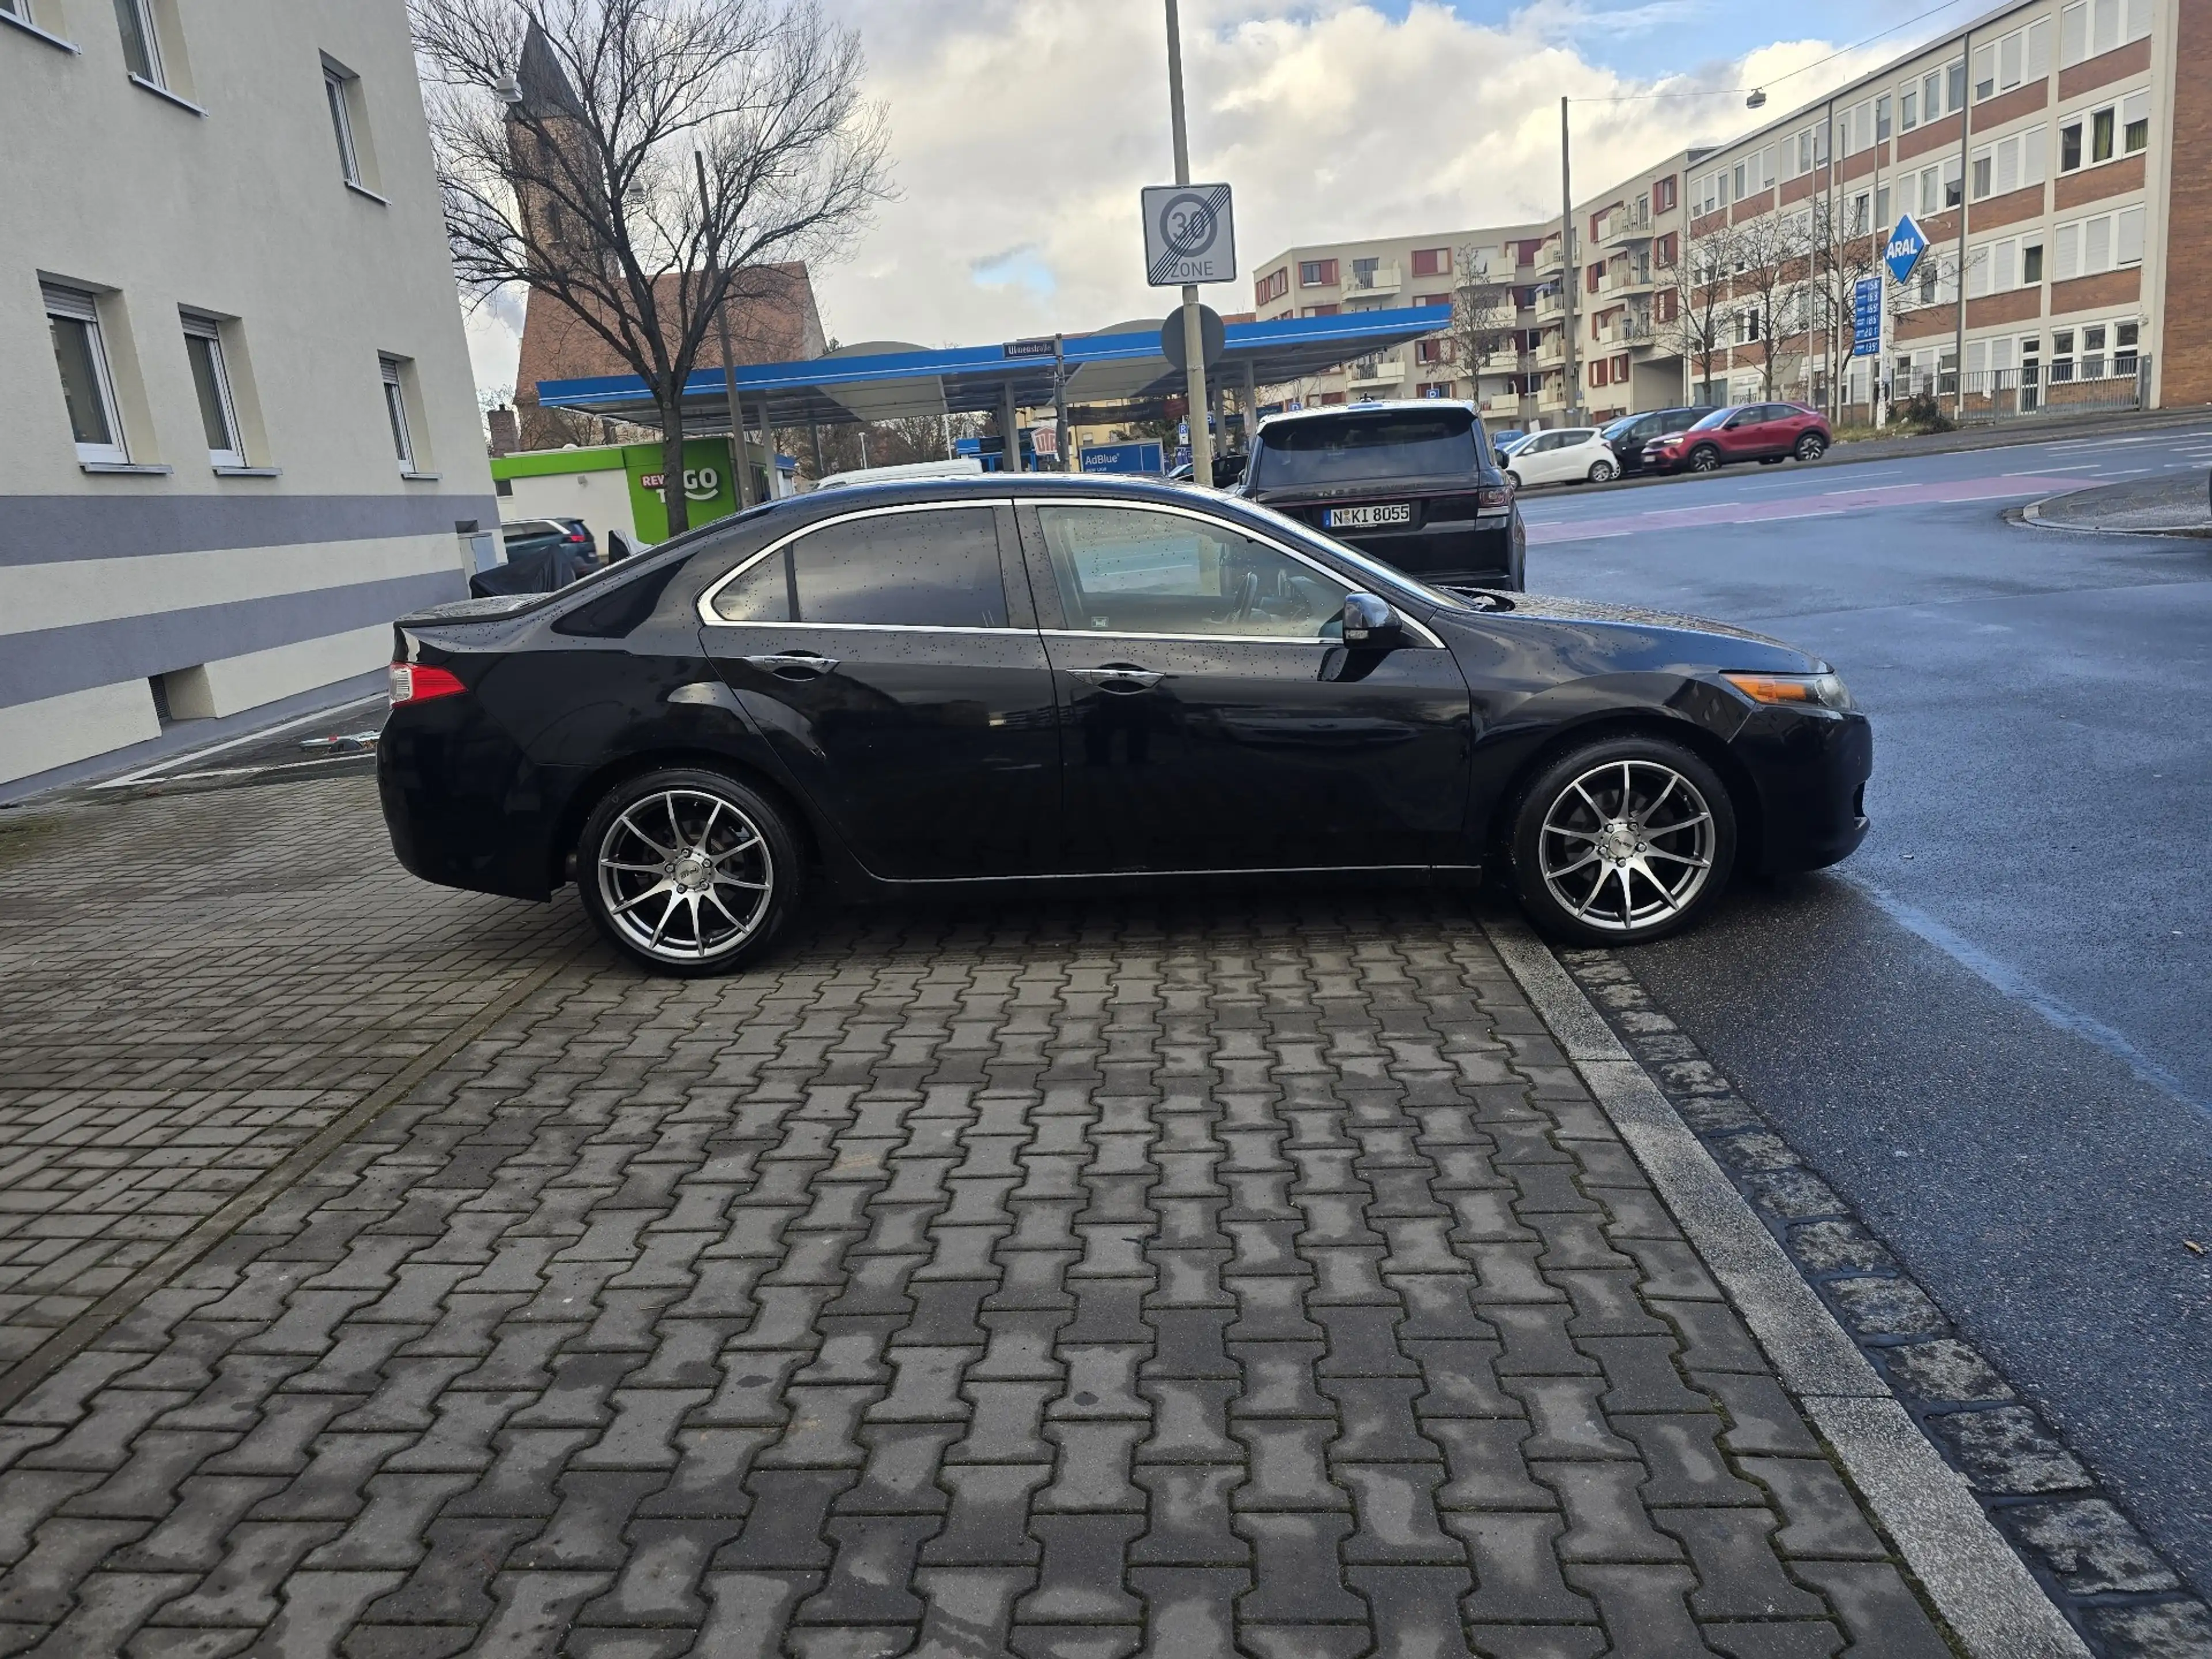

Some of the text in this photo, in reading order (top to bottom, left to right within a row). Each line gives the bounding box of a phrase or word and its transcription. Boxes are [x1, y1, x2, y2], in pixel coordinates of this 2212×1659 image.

[1172, 211, 1206, 240] 30
[1887, 238, 1917, 259] ARAL
[1171, 261, 1213, 278] ZONE
[683, 468, 718, 490] GO
[1334, 506, 1410, 525] N KI 8055
